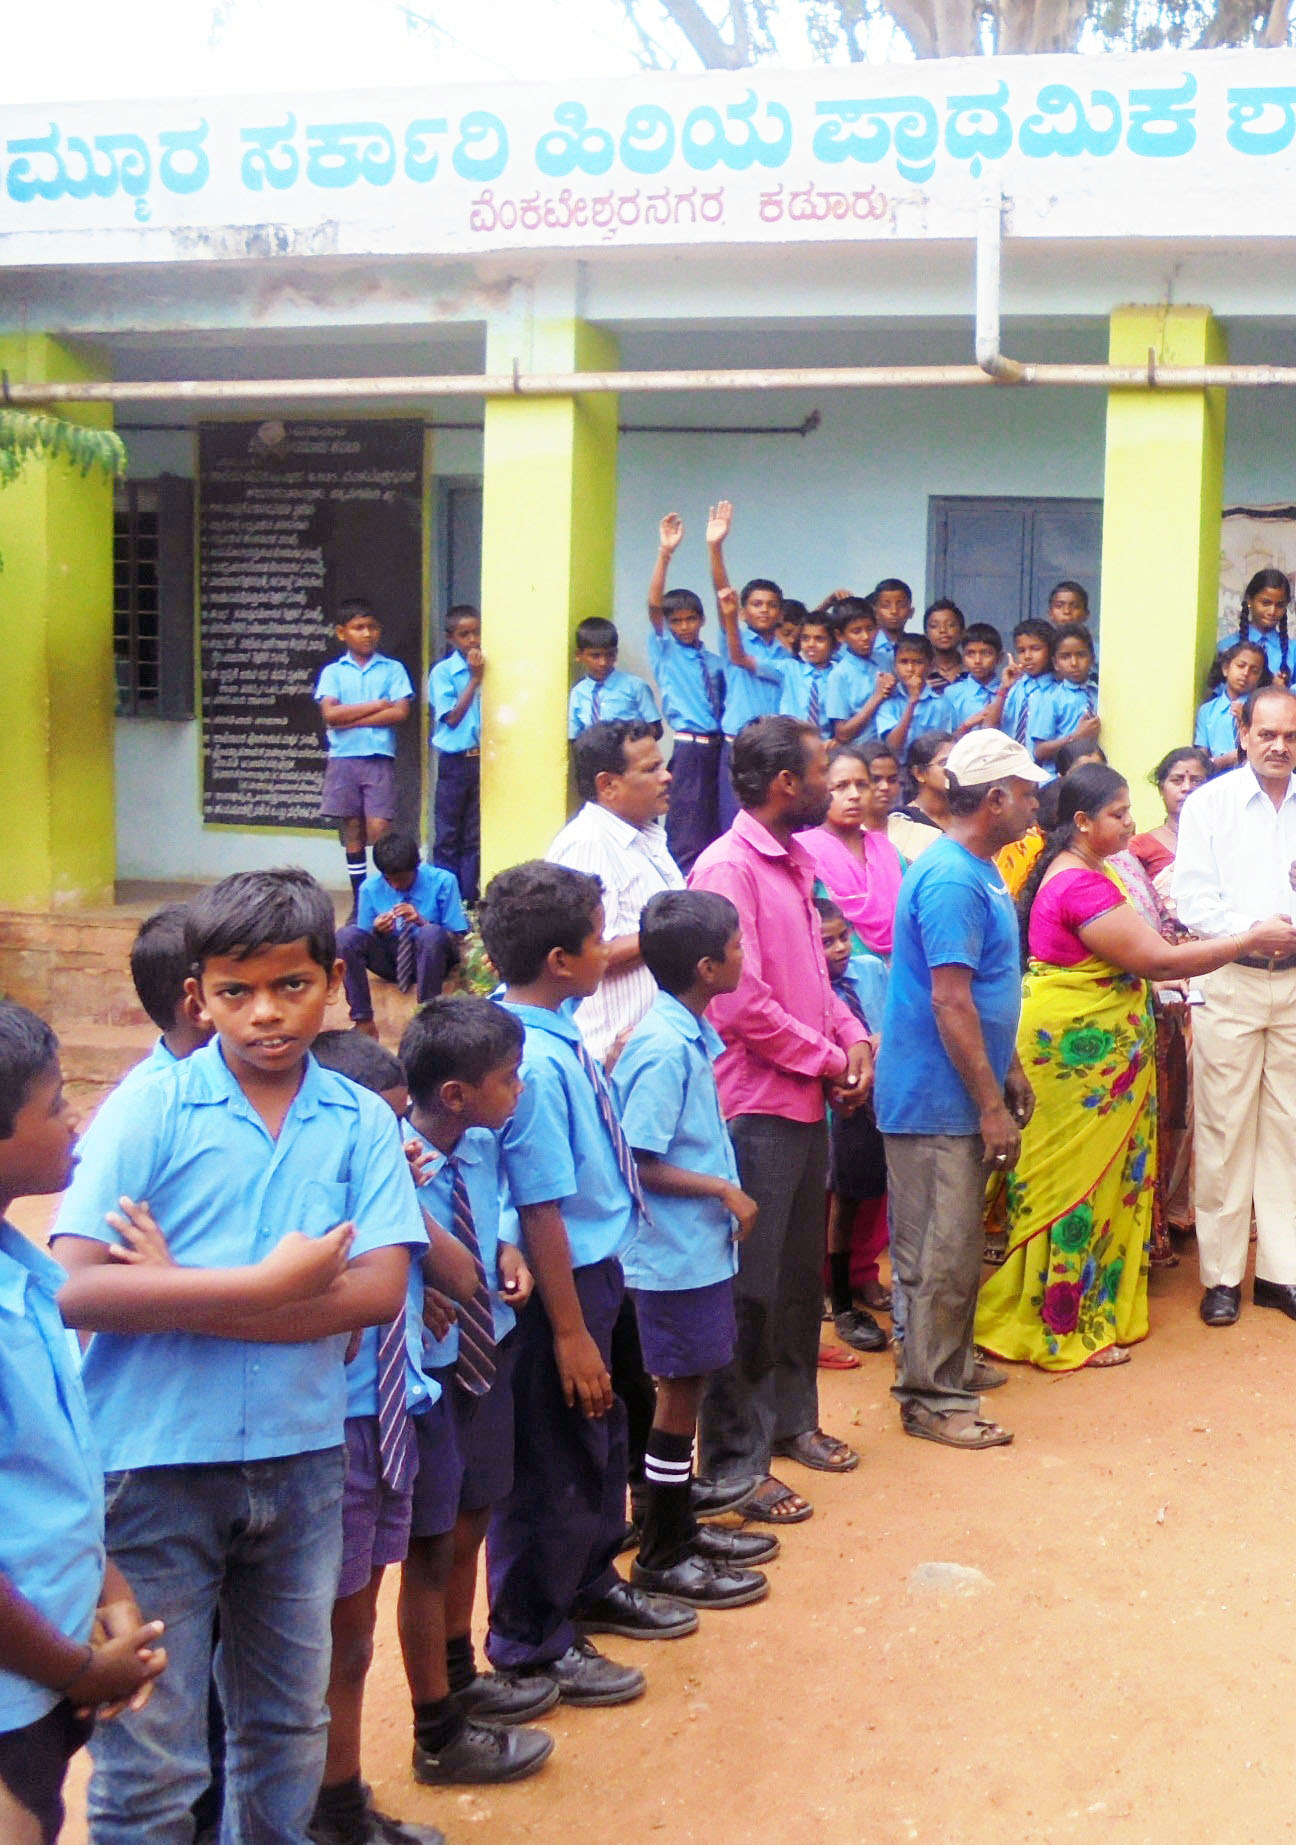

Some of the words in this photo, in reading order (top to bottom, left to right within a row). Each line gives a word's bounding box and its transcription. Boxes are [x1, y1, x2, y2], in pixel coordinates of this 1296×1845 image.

[240, 111, 510, 193] ಸರ್ಕಾರಿ
[534, 88, 793, 177] ಹಿರಿಯ
[812, 71, 1198, 184] ಪ್ರಾಥಮಿಕ
